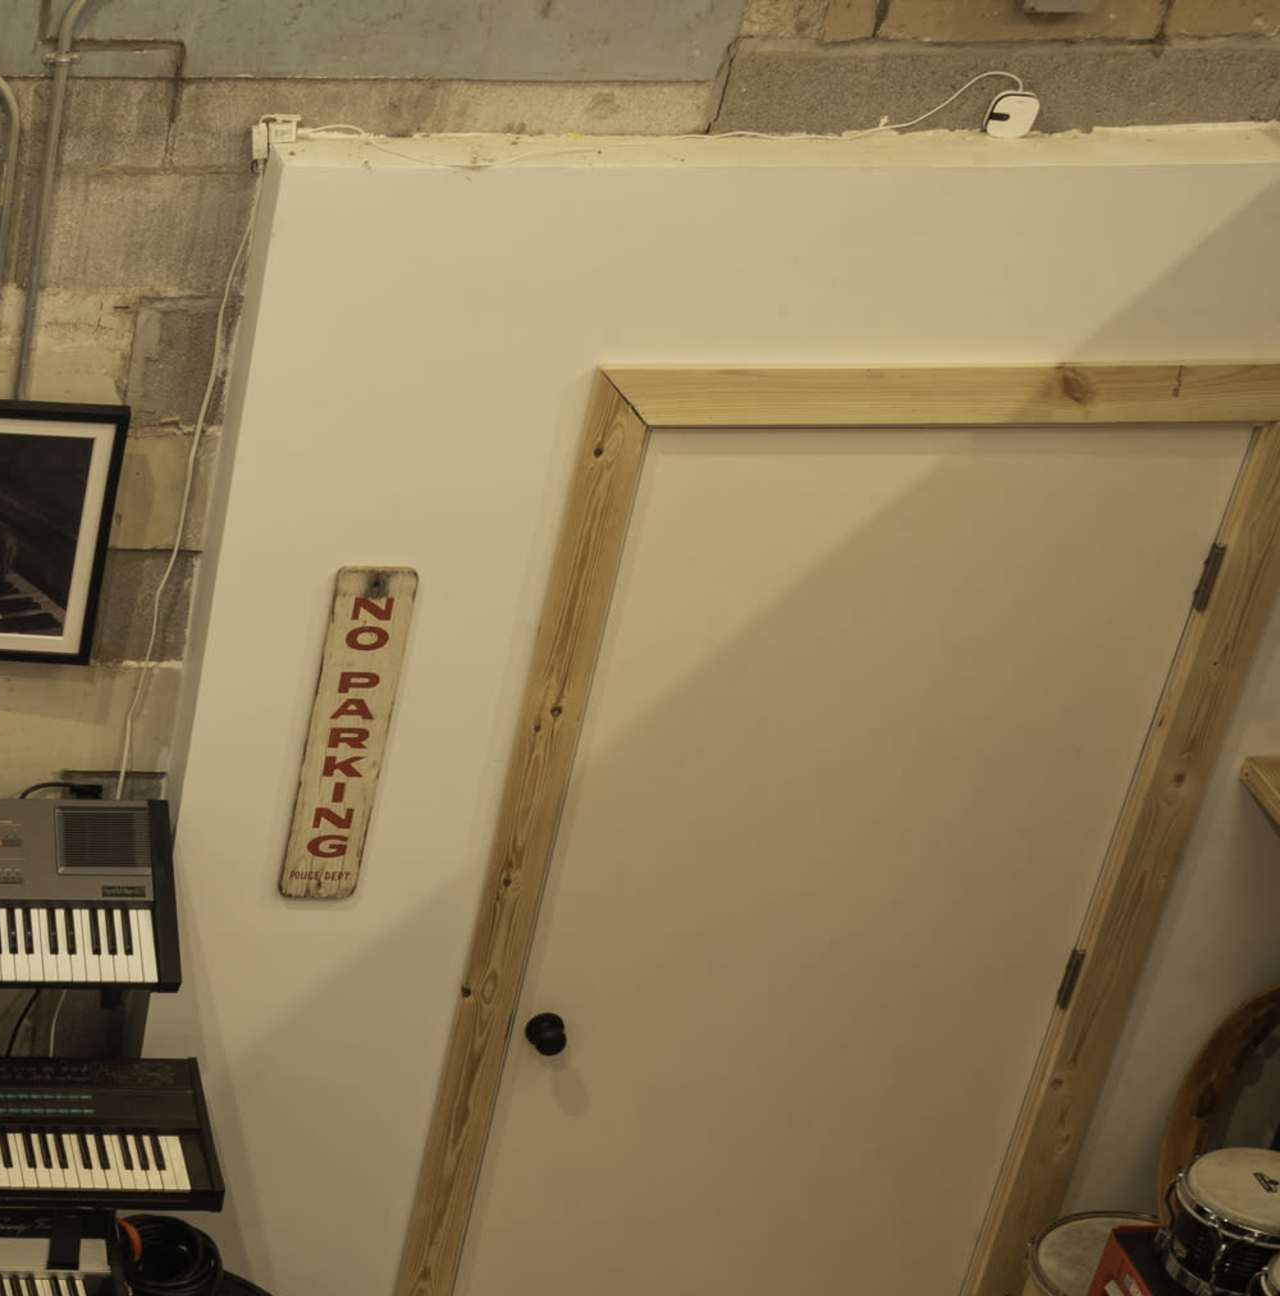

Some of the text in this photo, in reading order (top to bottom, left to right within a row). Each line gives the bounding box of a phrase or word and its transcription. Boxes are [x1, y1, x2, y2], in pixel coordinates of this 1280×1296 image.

[306, 596, 395, 859] NO PARKING
[289, 869, 320, 881] POLICE
